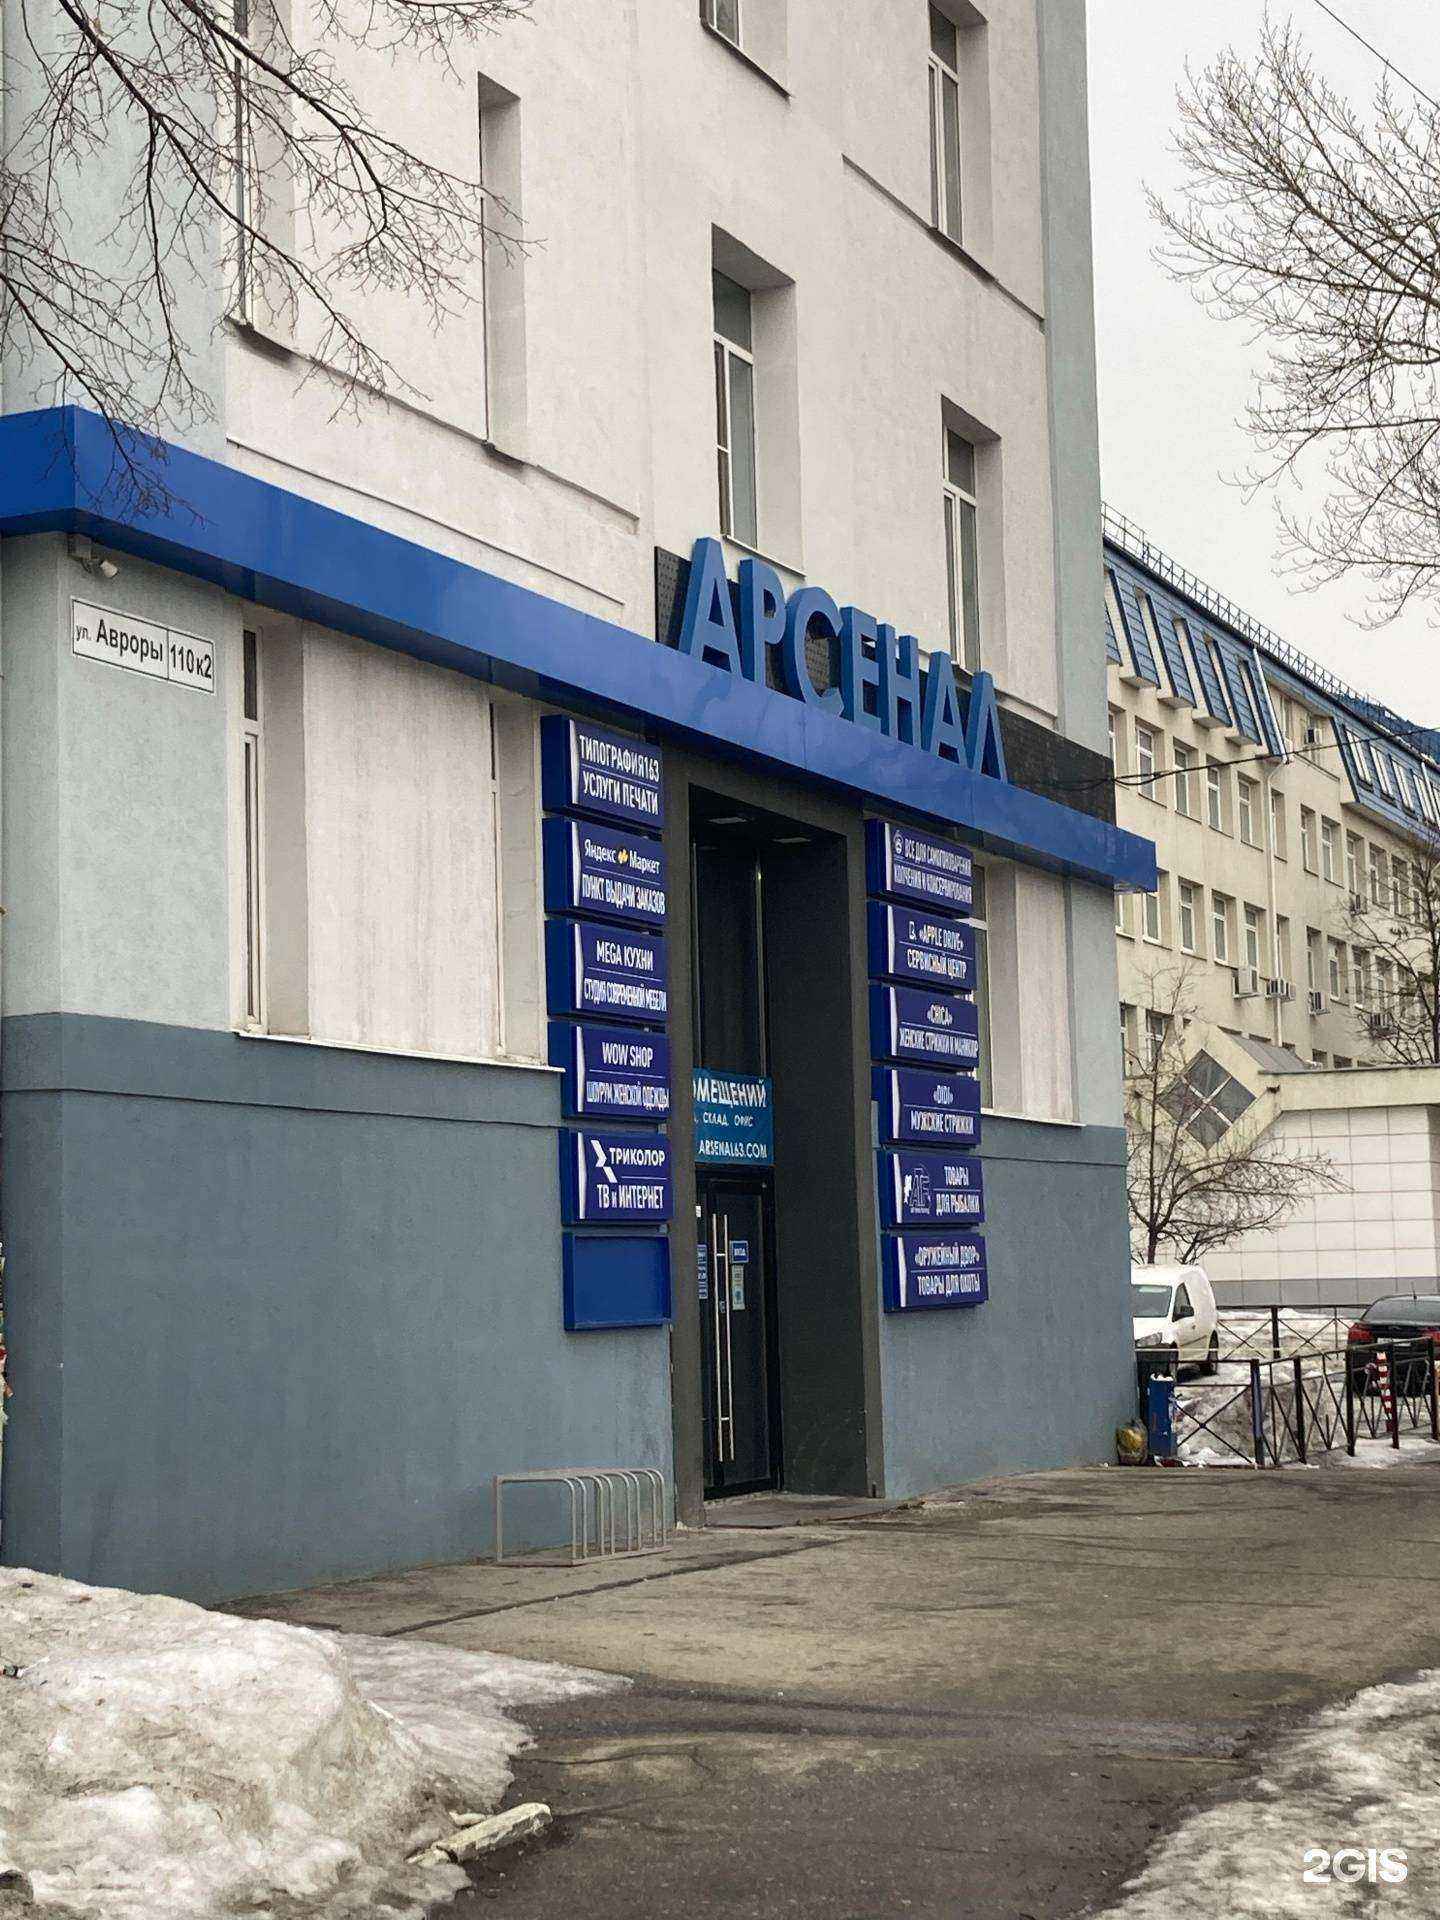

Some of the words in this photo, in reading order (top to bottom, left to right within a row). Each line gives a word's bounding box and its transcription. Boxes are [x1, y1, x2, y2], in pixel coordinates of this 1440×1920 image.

[76, 625, 92, 641] ул.
[97, 619, 163, 662] Авроры
[678, 537, 1008, 784] АРСЕНАЛ
[579, 734, 660, 782] ТИПОГРАФИЯ163
[583, 771, 620, 804] УСЛУГИ
[622, 783, 659, 815] ПЕЧАТИ
[584, 839, 617, 863] Яндекс
[629, 850, 660, 874] Маркет
[582, 873, 605, 901] ПУНКТ
[605, 878, 636, 909] ВЫДАЧИ
[636, 886, 665, 914] ЗАКАЗОВ
[596, 940, 623, 966] MEGA
[624, 946, 654, 971] КУХНИ
[948, 957, 967, 980] ЦЕНТР
[584, 977, 607, 1005] СТУДИЯ
[645, 988, 667, 1012] МЕБЕЛИ
[900, 1027, 925, 1050] ЖЕНСКИЕ
[602, 1042, 629, 1066] WOW
[629, 1045, 654, 1068] SHOP
[613, 1081, 642, 1106] ЖЕНСКОЙ
[642, 1086, 670, 1111] ОДЕЖДЫ
[911, 1110, 944, 1133] МУЖСКИЕ
[944, 1114, 974, 1134] СТРИЖКИ
[609, 1147, 665, 1167] ТРИКОЛОР
[699, 1140, 767, 1158] ARSENAL63.COM
[943, 1166, 969, 1186] ТОВАРЫ
[597, 1184, 610, 1209] ТВ
[611, 1190, 618, 1208] и
[618, 1185, 664, 1209] ИНТЕРНЕТ
[936, 1194, 950, 1216] ДЛЯ
[950, 1194, 980, 1213] РЫБАЛКИ
[917, 1275, 945, 1296] ТОВАРЫ
[945, 1274, 960, 1298] ДЛЯ
[960, 1273, 981, 1294] ОХОТЫ
